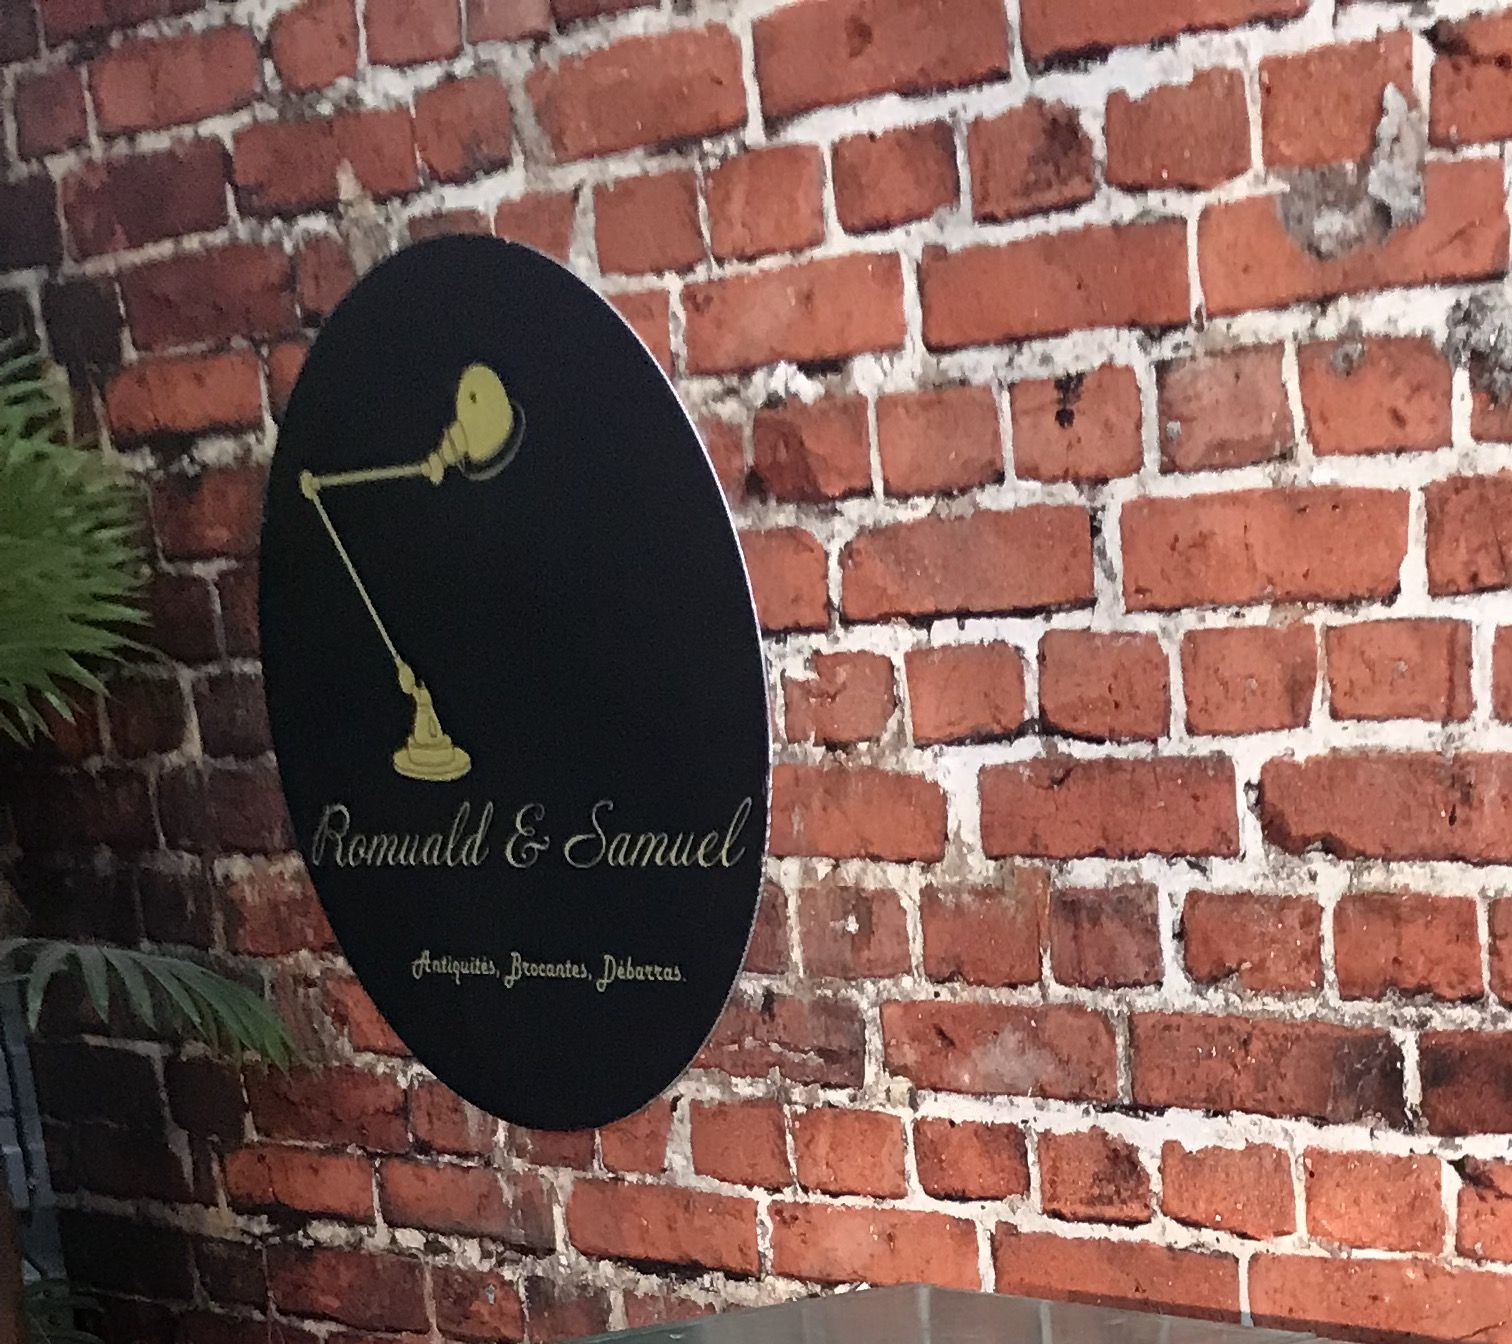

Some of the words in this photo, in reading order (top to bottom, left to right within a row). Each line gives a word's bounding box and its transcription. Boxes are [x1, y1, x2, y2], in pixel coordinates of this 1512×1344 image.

[311, 800, 494, 868] Romuald
[505, 803, 550, 869] &
[563, 797, 752, 868] Samuel
[411, 949, 500, 985] Antiquités,
[504, 951, 592, 989] Brocantes,
[596, 954, 687, 993] Débarras.
